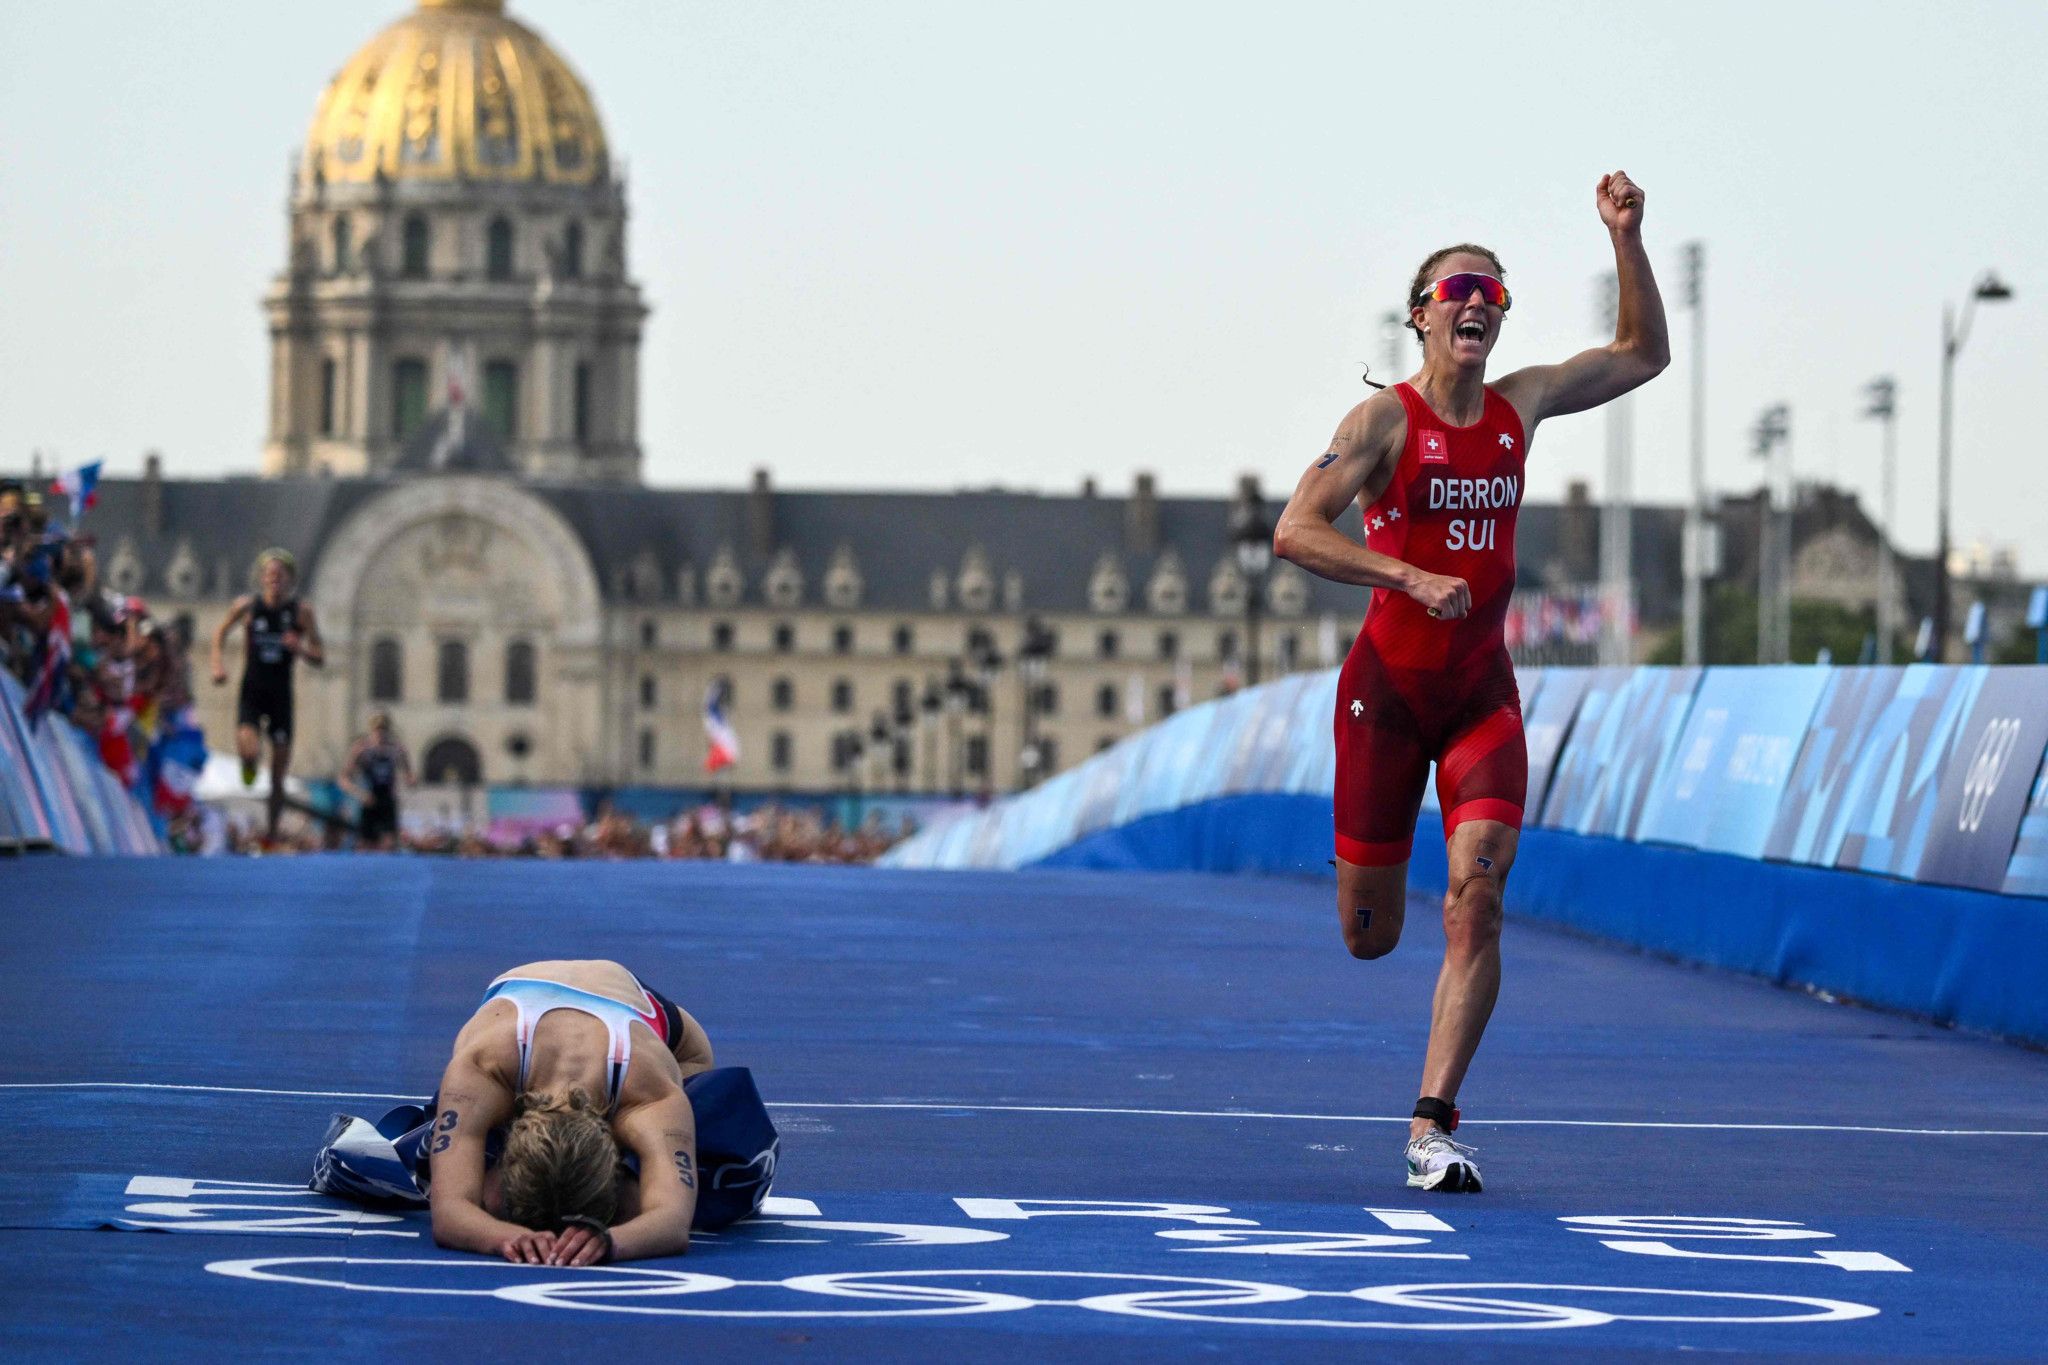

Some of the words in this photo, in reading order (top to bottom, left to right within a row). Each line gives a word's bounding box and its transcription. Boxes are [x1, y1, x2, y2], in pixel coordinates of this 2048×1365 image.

[1316, 453, 1340, 469] 7
[1428, 475, 1518, 510] DERRON
[1445, 518, 1496, 551] SUI
[1476, 857, 1493, 871] 7
[1356, 908, 1373, 930] 7
[123, 1176, 1837, 1240] PRIS
